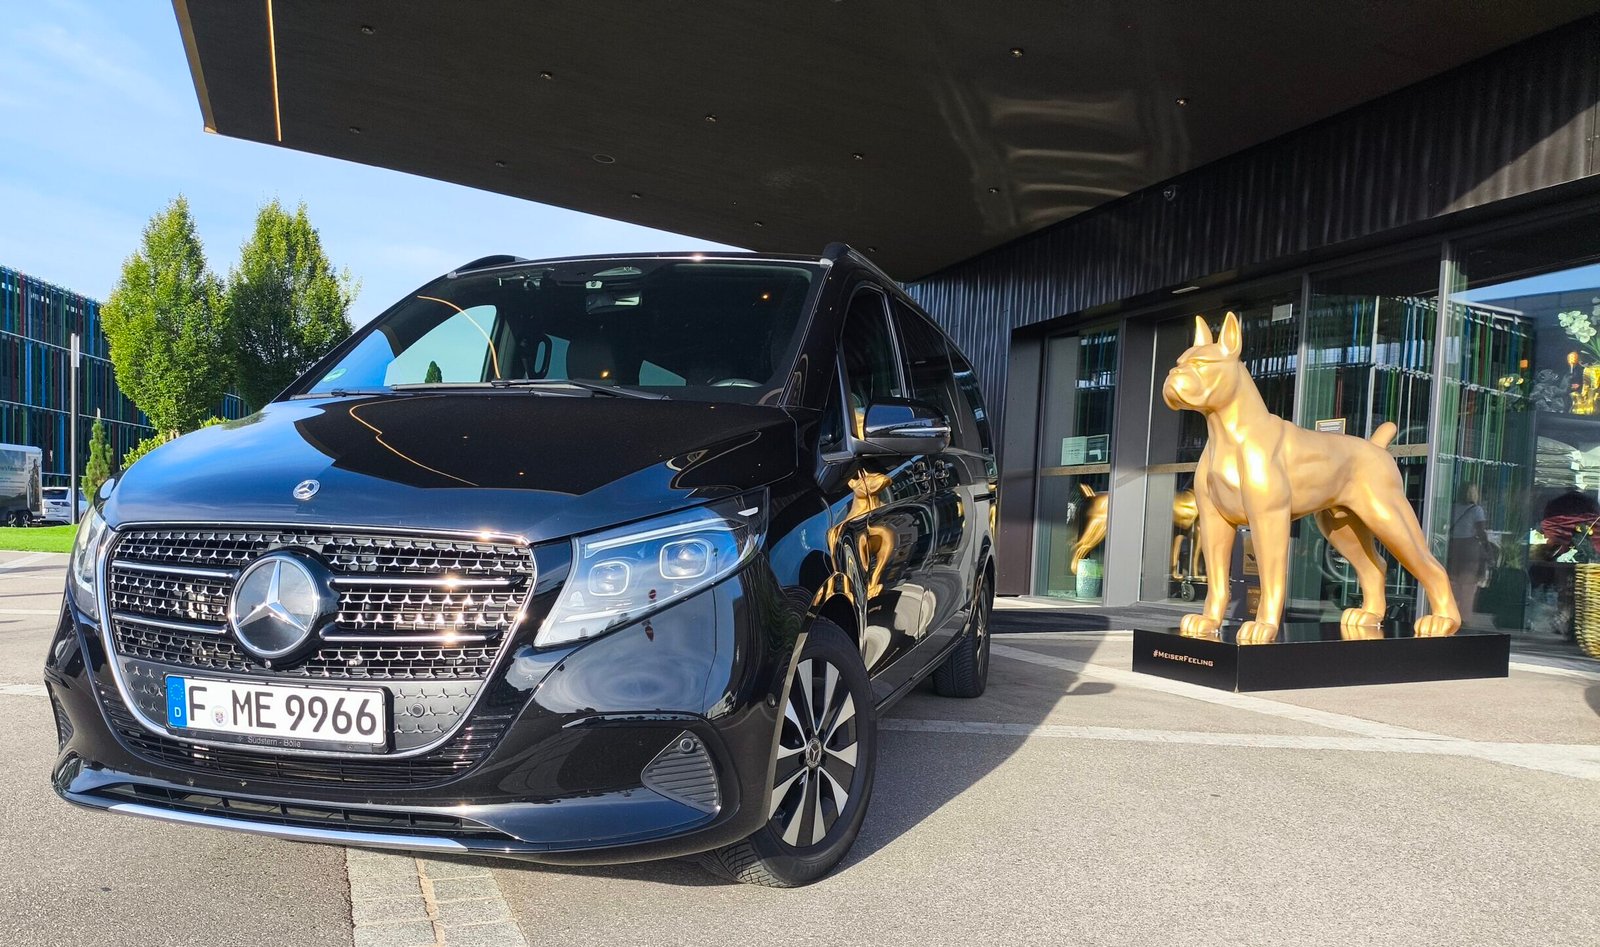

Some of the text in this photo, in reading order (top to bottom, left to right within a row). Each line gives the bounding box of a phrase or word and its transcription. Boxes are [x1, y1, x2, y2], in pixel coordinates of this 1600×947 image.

[173, 706, 182, 718] D
[188, 685, 377, 736] F ME 9966
